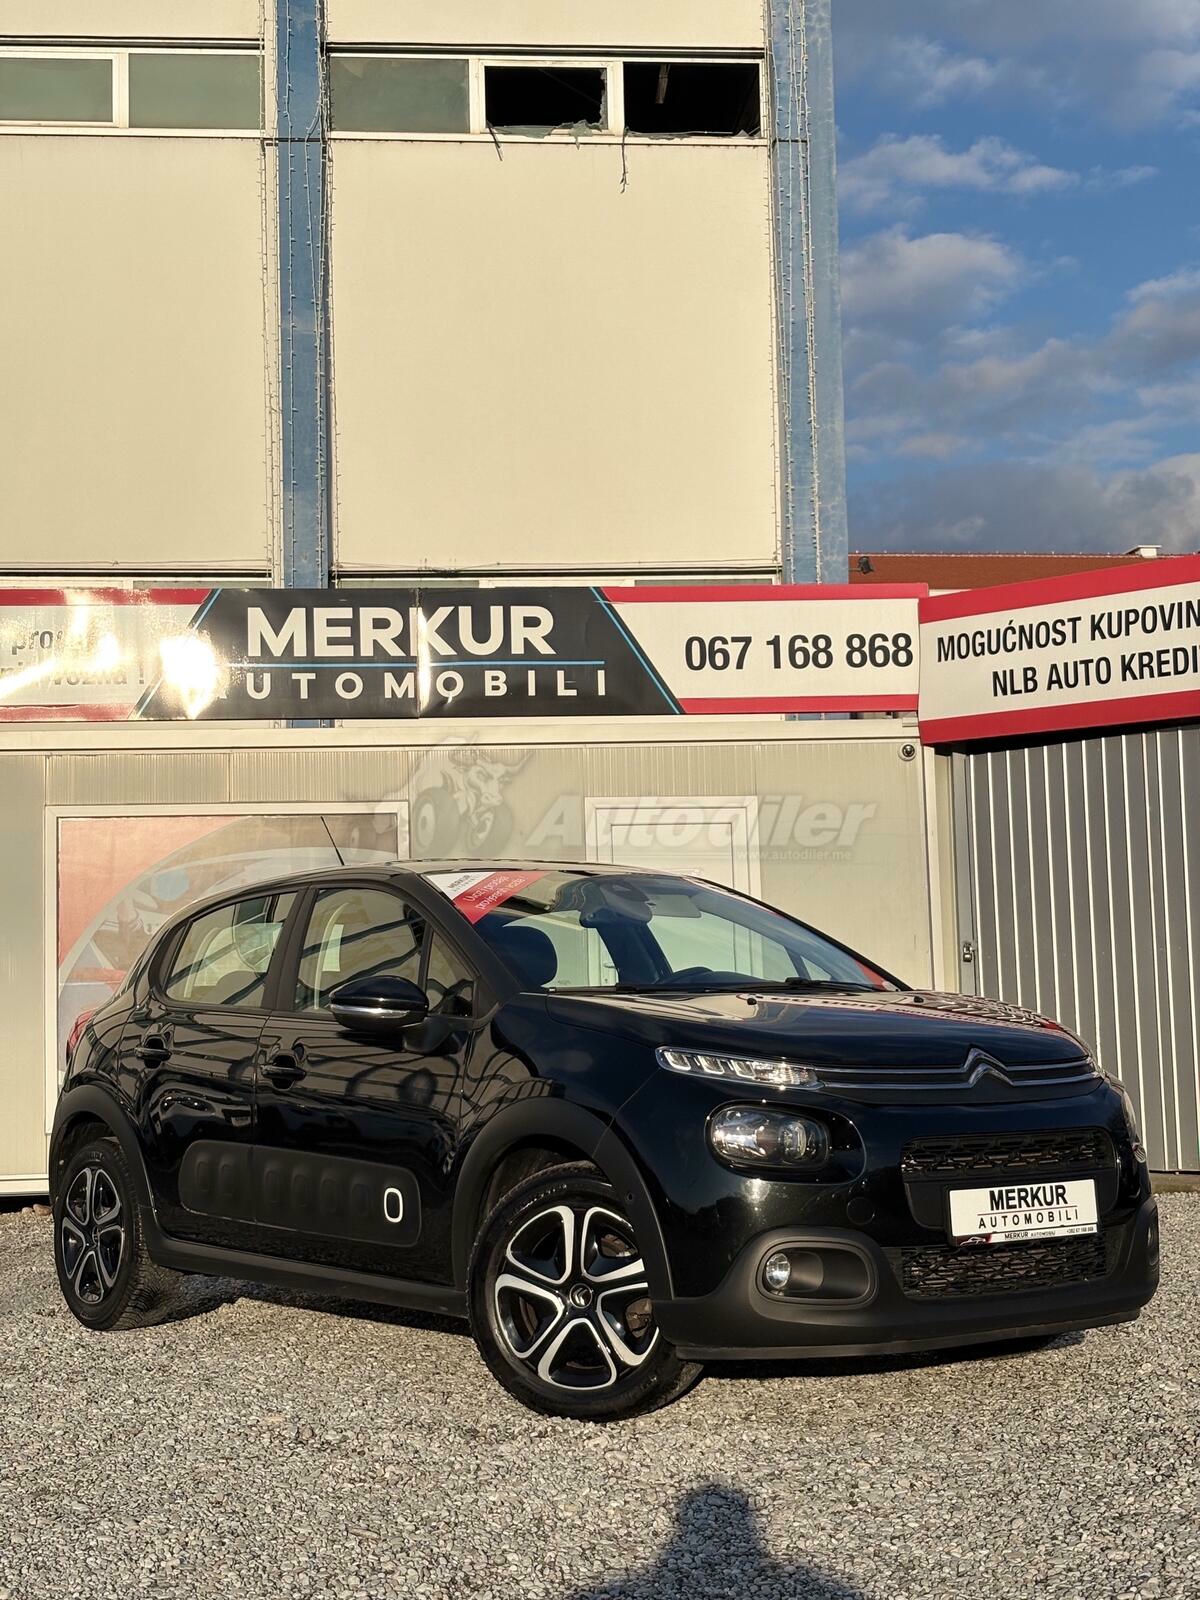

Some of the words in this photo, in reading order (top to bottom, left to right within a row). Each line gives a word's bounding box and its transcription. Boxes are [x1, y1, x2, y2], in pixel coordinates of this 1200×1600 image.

[247, 605, 556, 657] MERKUR
[937, 616, 1082, 662] MOGUĆNOST
[684, 635, 752, 671] 067
[766, 633, 834, 669] 168
[845, 632, 913, 668] 868
[215, 669, 606, 700] UTOMOBILI
[992, 665, 1038, 697] NLB
[1046, 655, 1112, 691] AUTO
[989, 1184, 1068, 1211] MERKUR
[978, 1208, 1079, 1229] AUTOMOBILI
[1004, 1231, 1029, 1240] MERKUR
